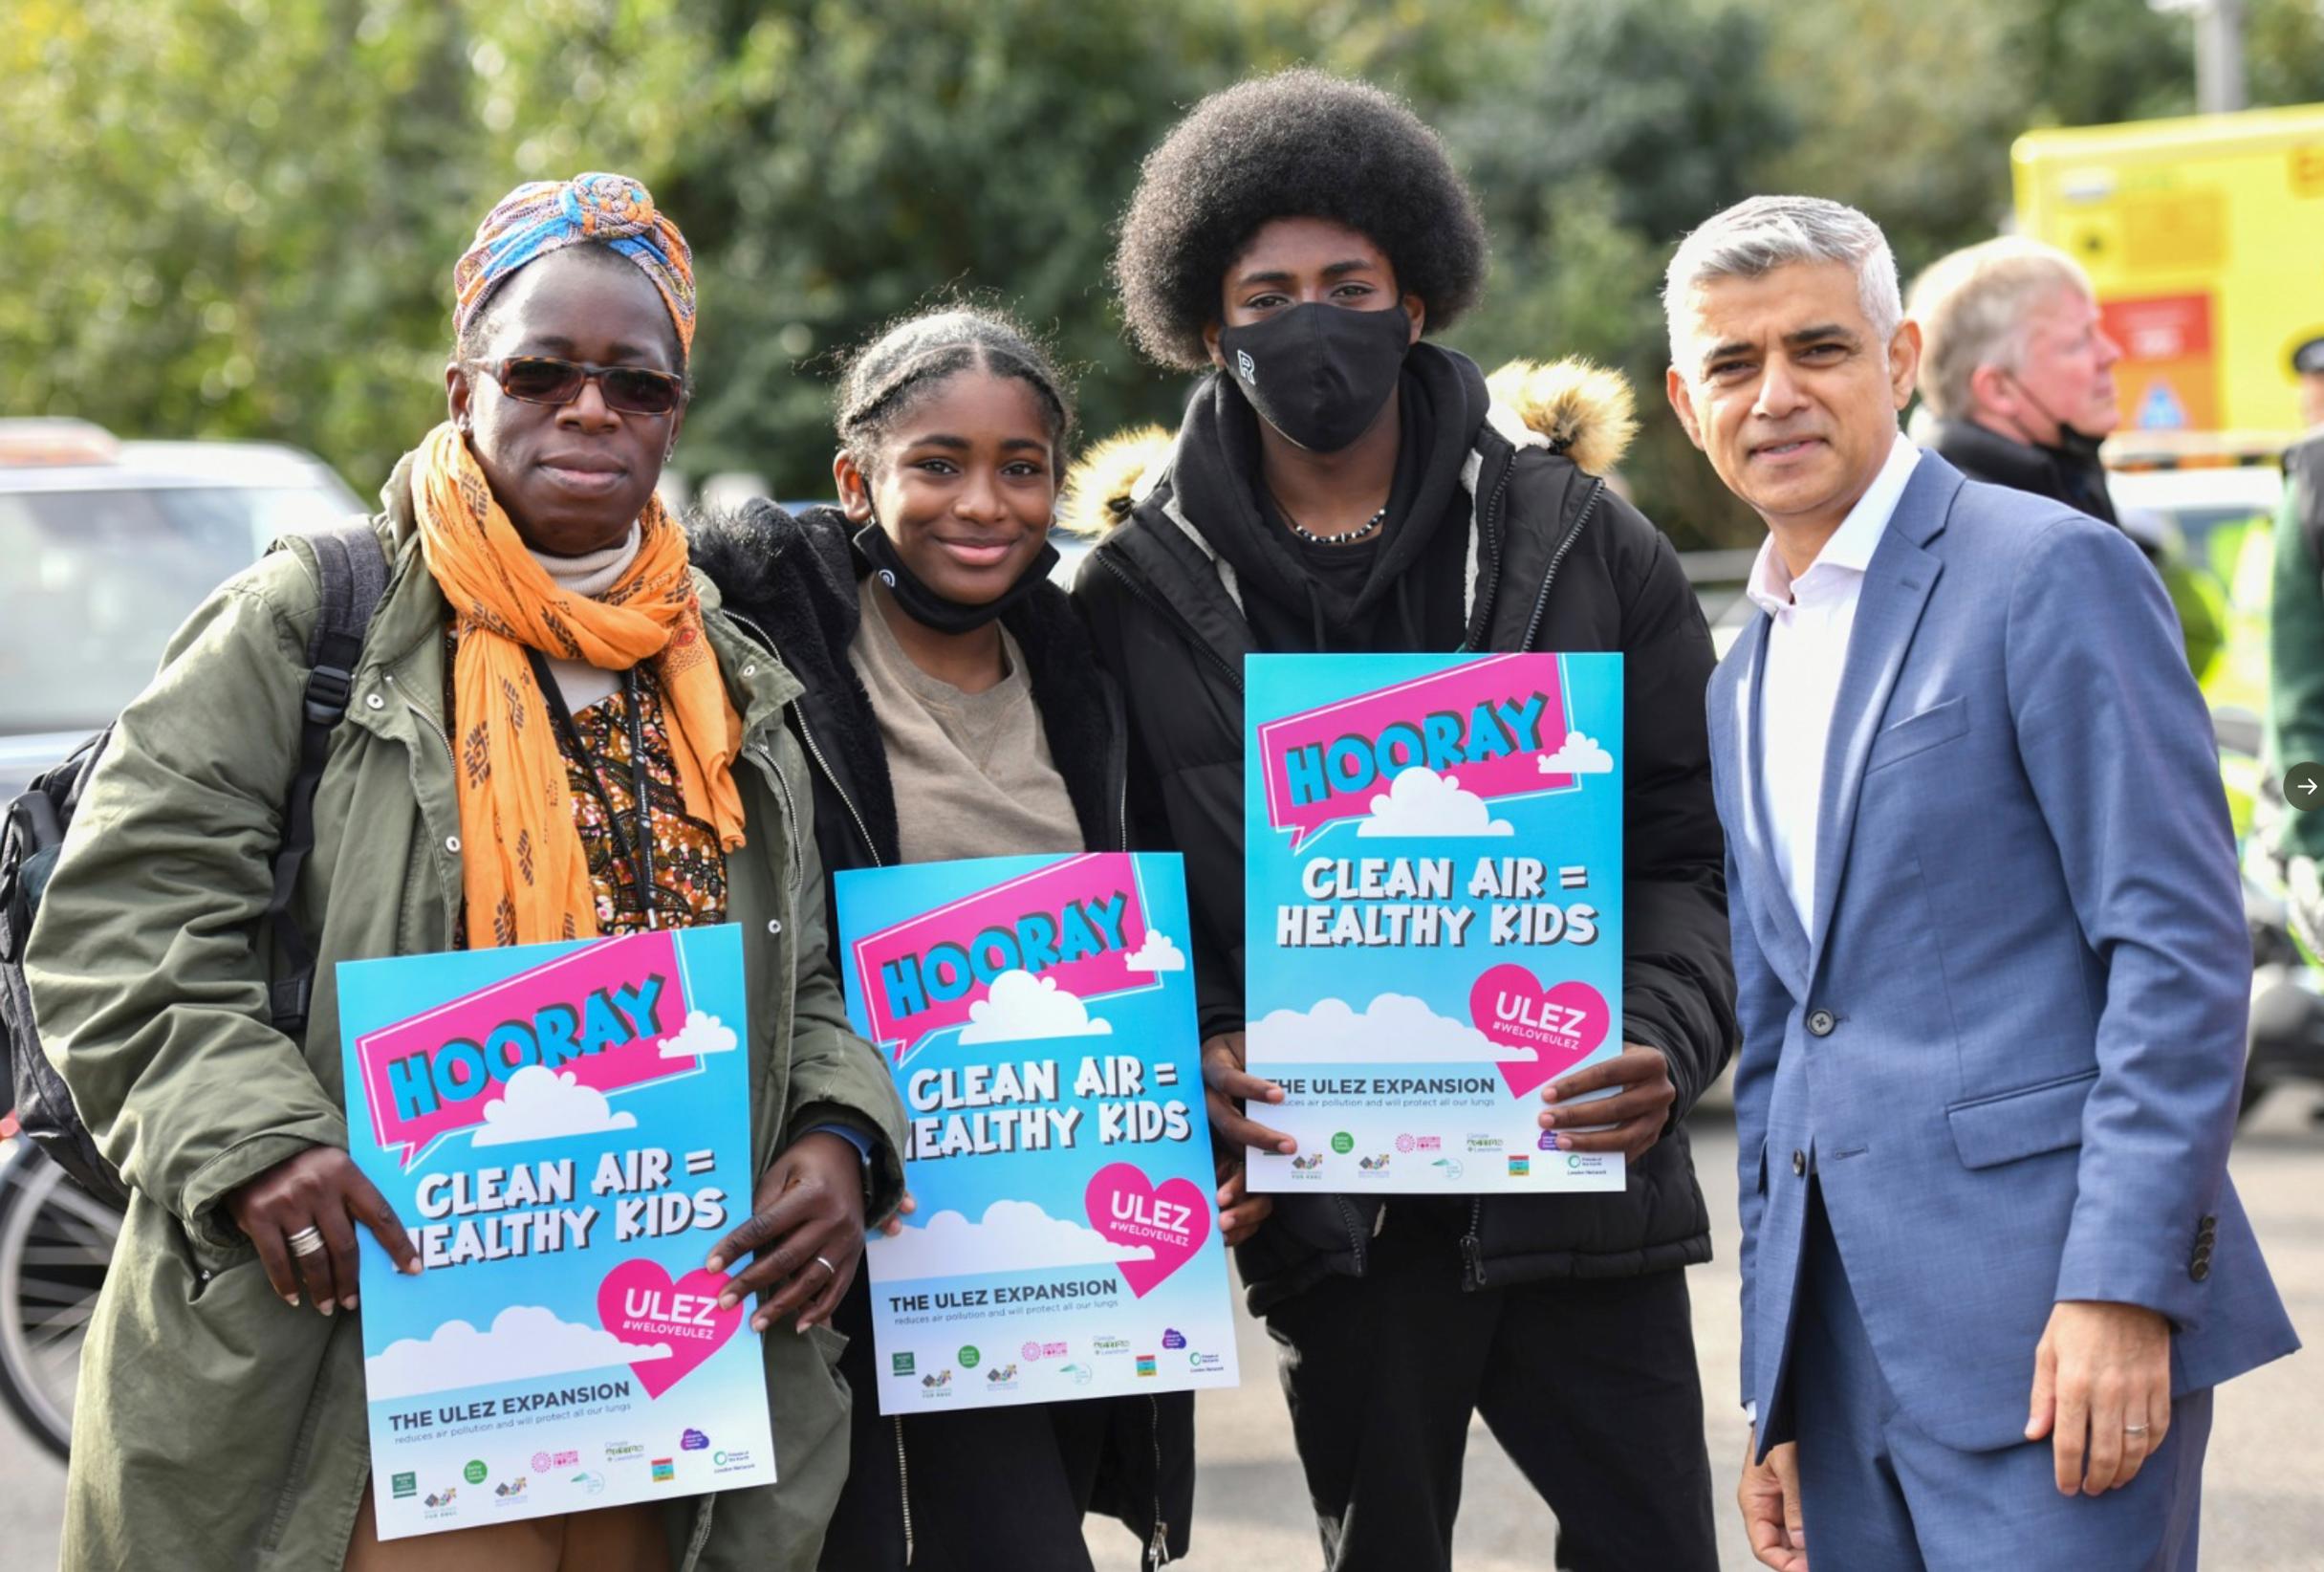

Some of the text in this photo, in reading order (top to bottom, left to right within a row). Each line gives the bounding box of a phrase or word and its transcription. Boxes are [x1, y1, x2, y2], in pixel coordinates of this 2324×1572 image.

[1284, 690, 1549, 807] HOORAY
[1301, 857, 1588, 901] CLEAN AIR =
[1276, 904, 1599, 946] HEALTHY KIDS
[880, 890, 1128, 1020] HOORAY
[1492, 1021, 1579, 1050] #WELOVEULEZ
[1496, 991, 1587, 1038] ULEZ
[386, 972, 665, 1123] HOORAY
[907, 1056, 1179, 1112] CLEAN AIR =
[1308, 1099, 1319, 1107] air
[1322, 1099, 1361, 1108] pollution
[1365, 1099, 1382, 1107] and
[1385, 1099, 1401, 1107] will
[1402, 1099, 1437, 1108] protect
[1470, 1099, 1495, 1108] lungs
[1313, 1079, 1367, 1094] ULEZ
[1373, 1078, 1495, 1094] EXPANSION
[1098, 1100, 1192, 1146] KIDS
[415, 1148, 717, 1219] CLEAN AIR =
[615, 1188, 728, 1243] KIDS
[1109, 1221, 1189, 1247] #WELOVEULEZ
[1111, 1190, 1191, 1234] ULEZ
[625, 1288, 718, 1327] ULEZ
[889, 1278, 1118, 1313] THE ULEZ EXPANSION
[894, 1298, 1119, 1326] reduces air pollution and will protect all our lungs
[621, 1320, 714, 1340] #WELOVEULEZ
[389, 1381, 631, 1431] THE ULEZ EXPANSION
[394, 1402, 631, 1445] reduces air pollution and will protect all our lungs
